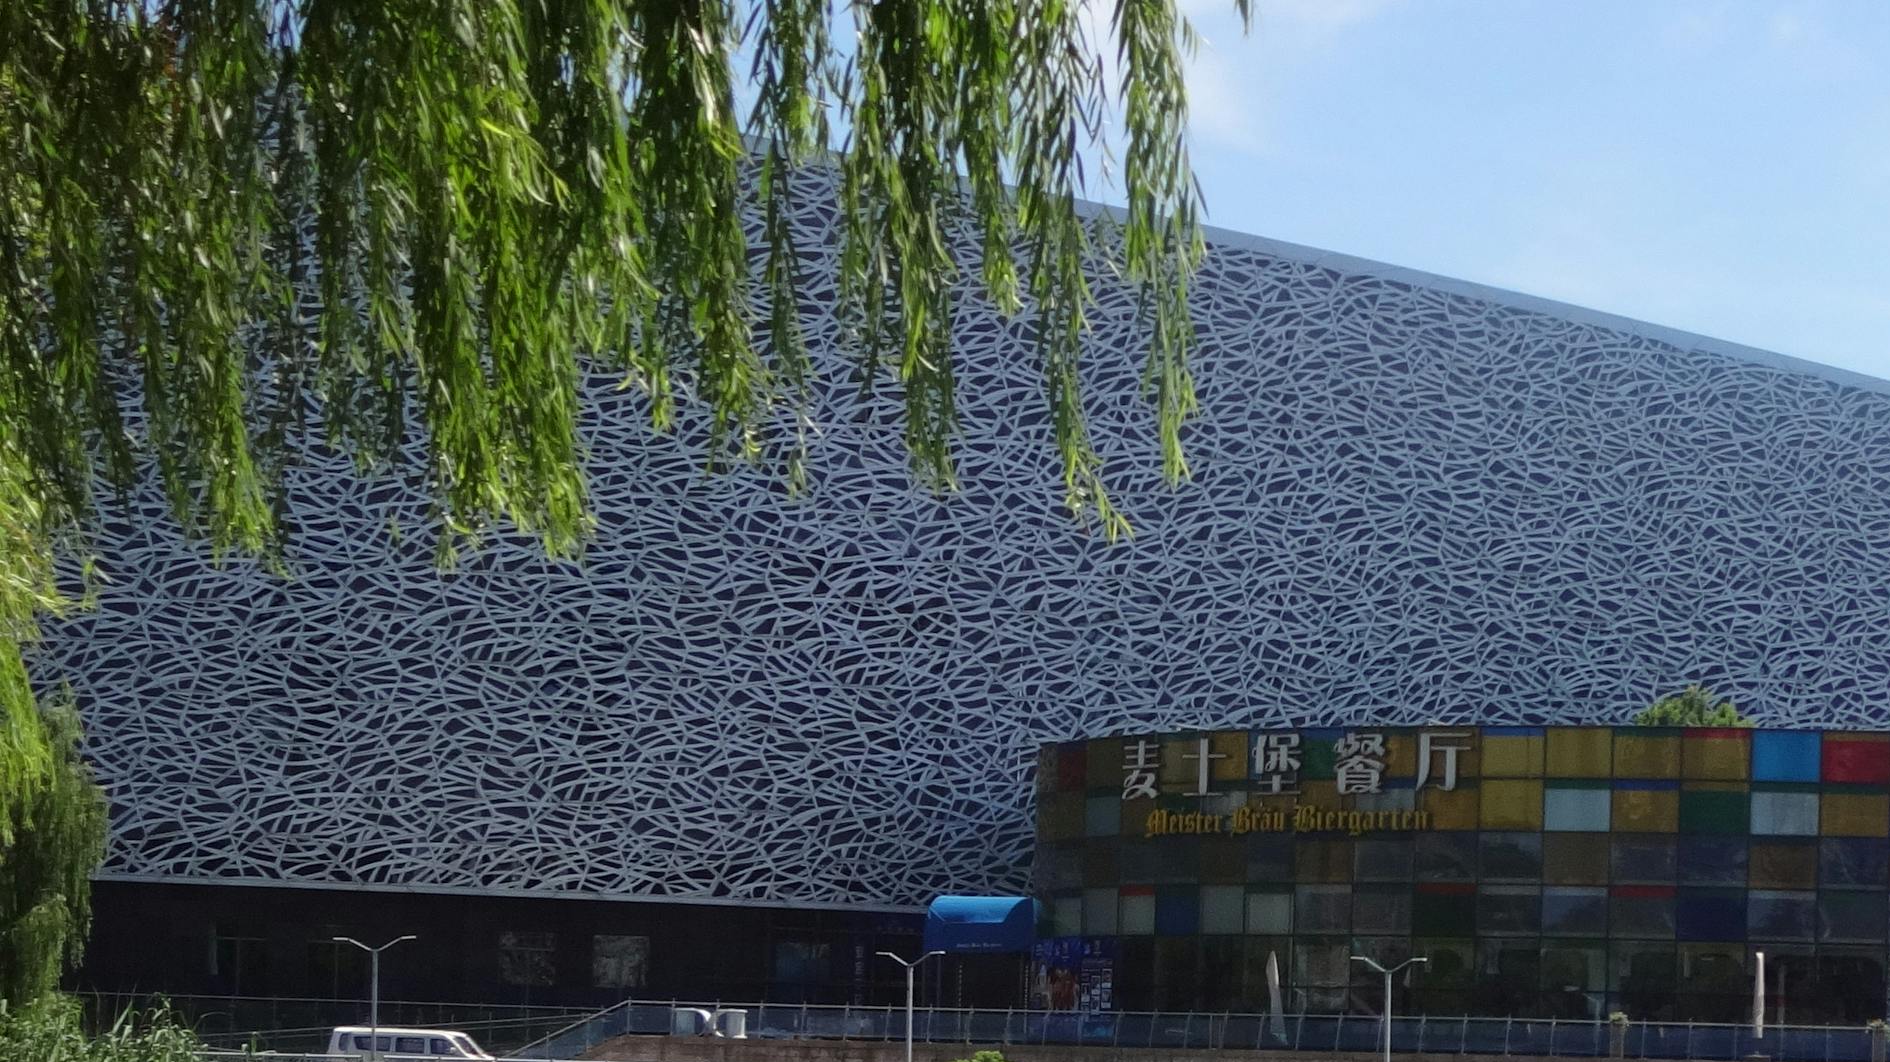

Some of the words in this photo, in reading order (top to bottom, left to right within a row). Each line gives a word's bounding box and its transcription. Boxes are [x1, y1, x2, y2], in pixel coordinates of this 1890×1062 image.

[1121, 732, 1473, 800] 麦士堡餐厅
[1145, 808, 1223, 838] Meister
[1293, 804, 1430, 837] Biergarten
